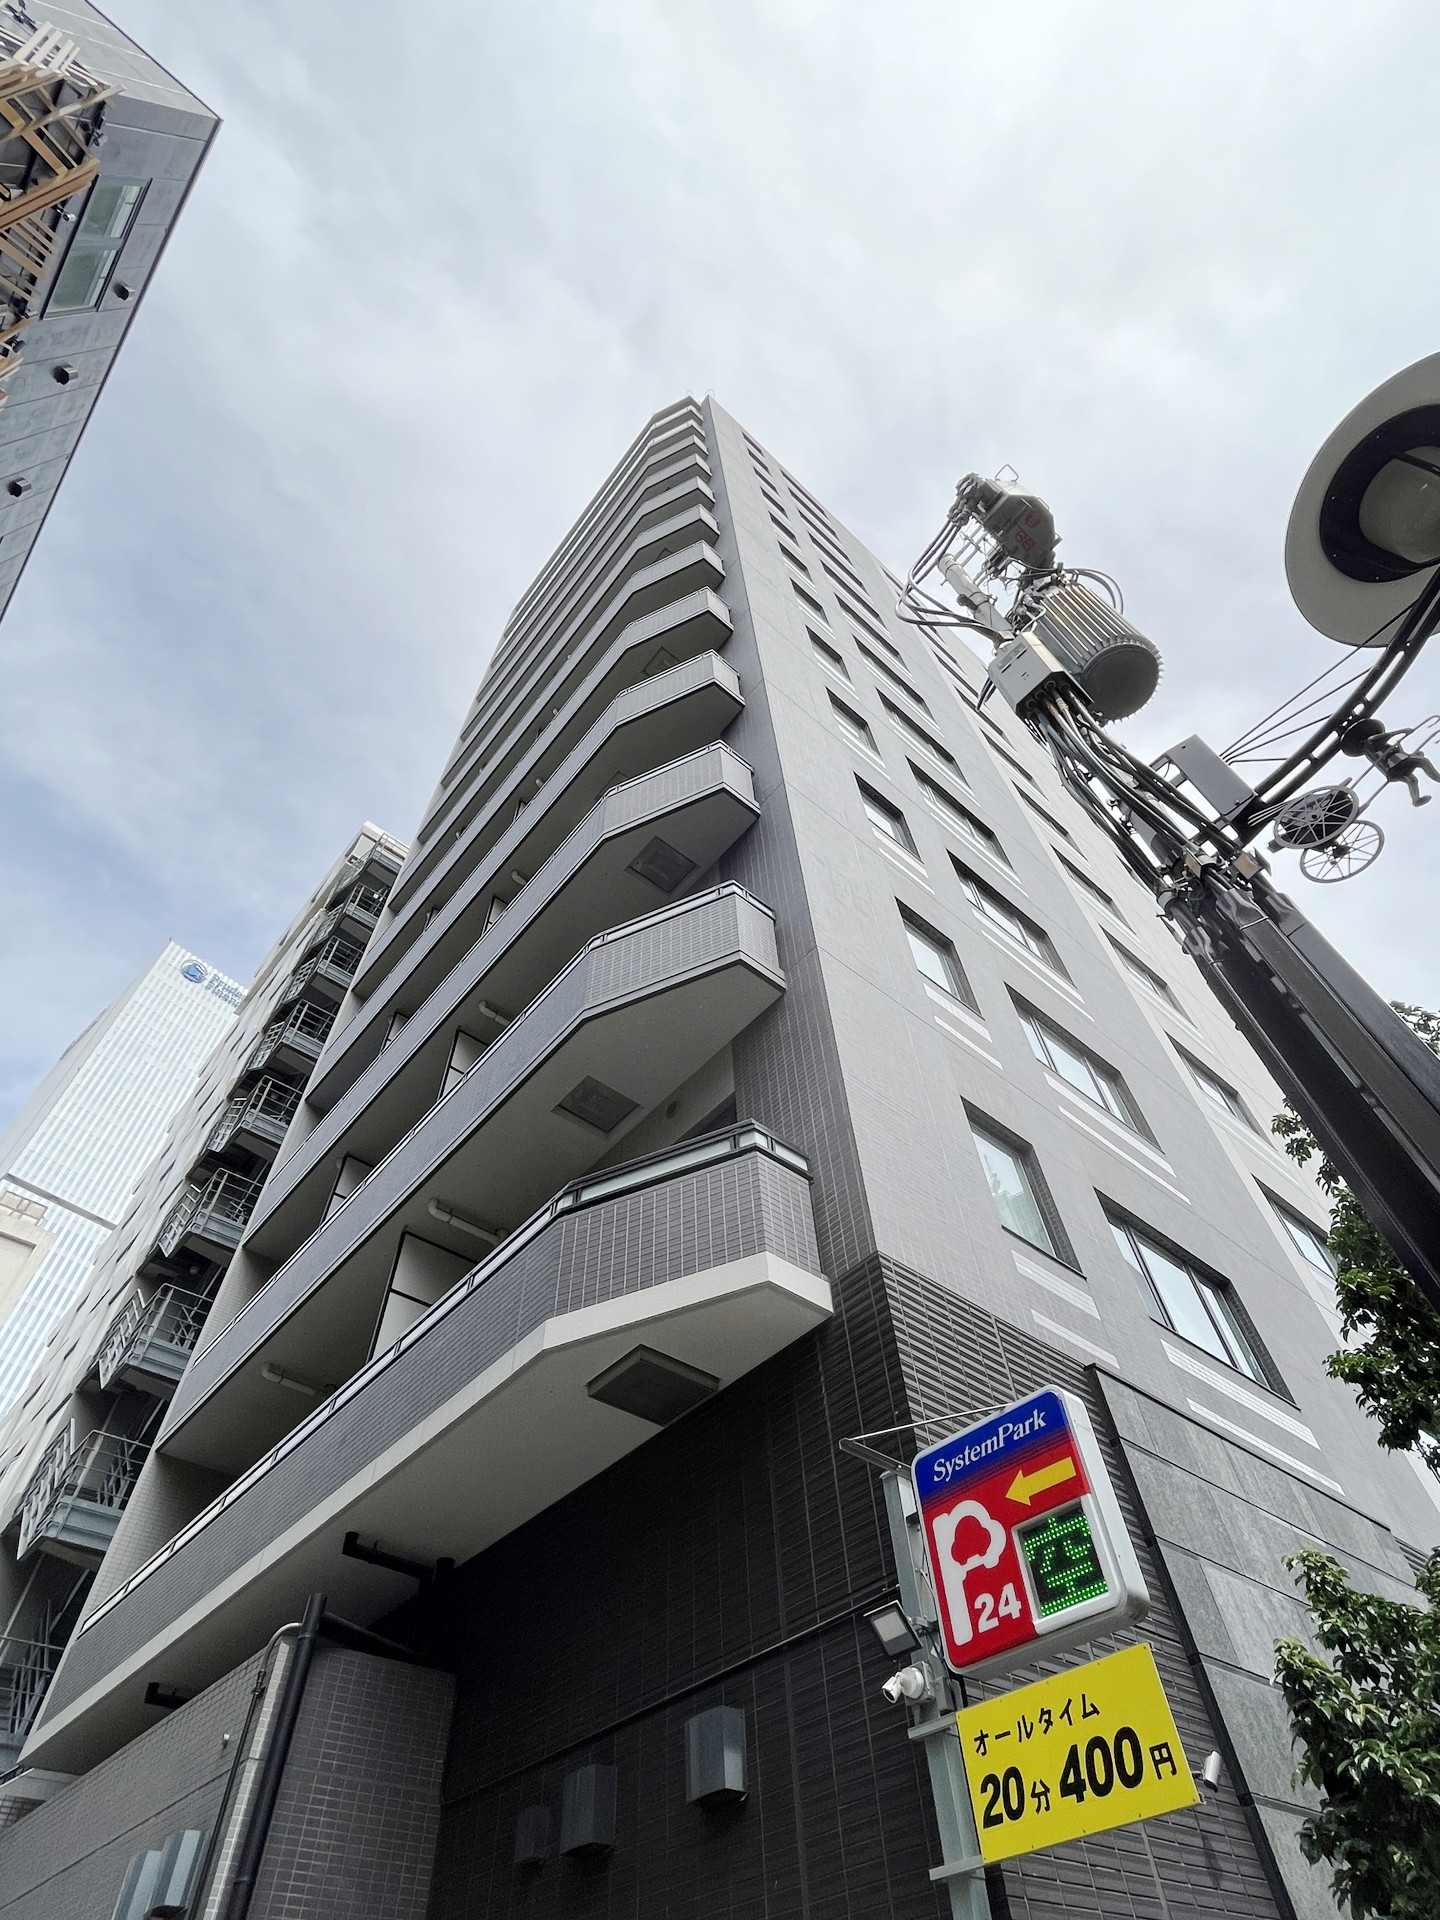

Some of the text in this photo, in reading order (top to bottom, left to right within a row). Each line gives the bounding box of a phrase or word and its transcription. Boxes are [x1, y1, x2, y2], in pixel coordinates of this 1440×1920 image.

[932, 1408, 1047, 1482] SystemPark
[1023, 1514, 1109, 1618] 空
[974, 1583, 1022, 1634] 24
[973, 1693, 1100, 1757] オールタイム
